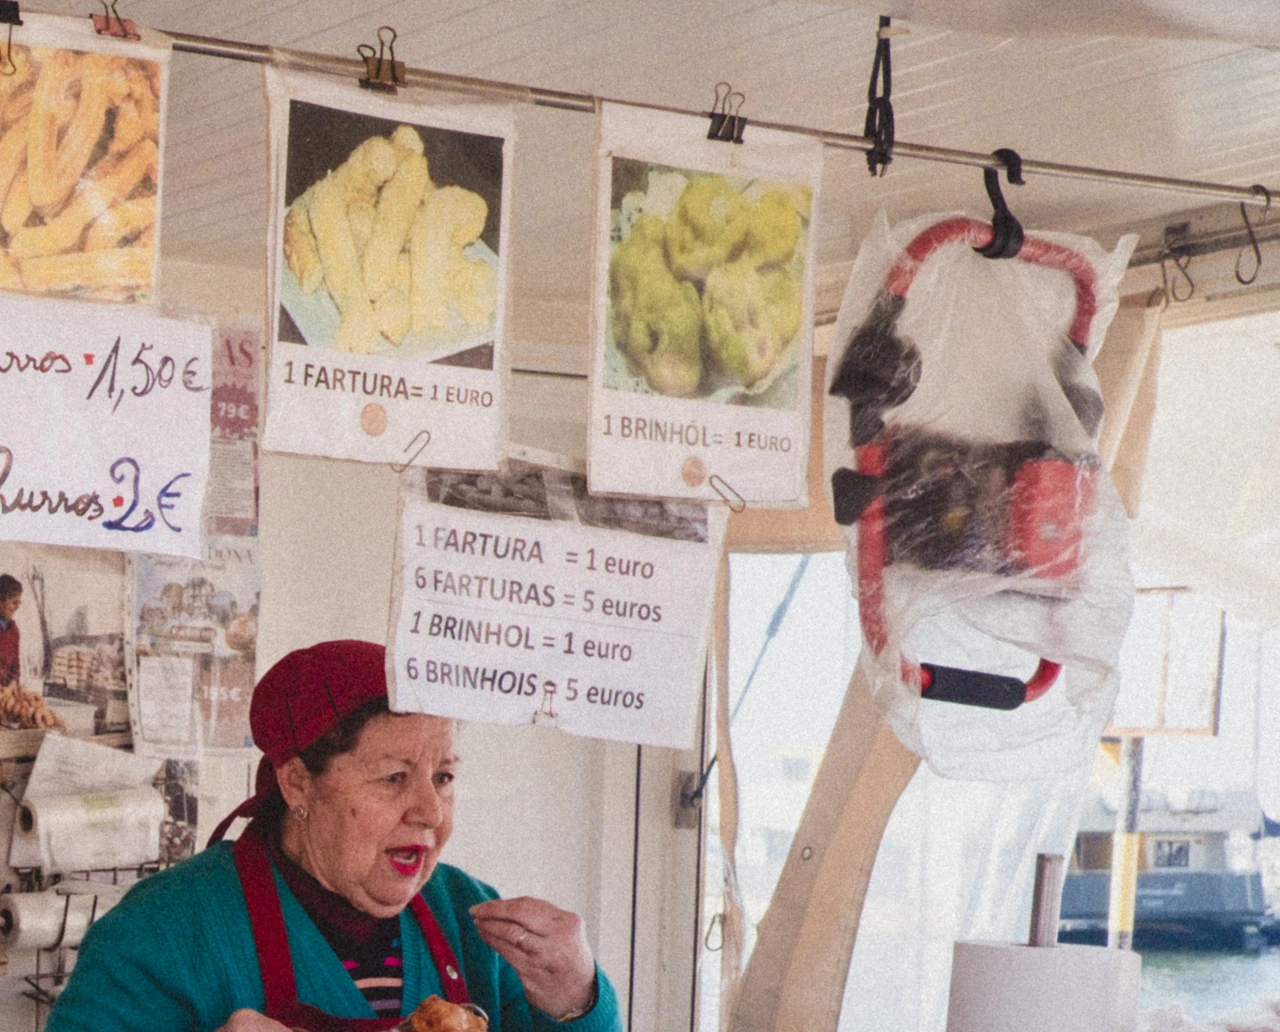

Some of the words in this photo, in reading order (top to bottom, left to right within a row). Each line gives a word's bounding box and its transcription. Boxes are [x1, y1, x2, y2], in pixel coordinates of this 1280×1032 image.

[283, 361, 295, 383] 1
[430, 384, 439, 400] 1
[446, 387, 494, 408] EURO
[603, 414, 612, 436] 1
[734, 431, 742, 447] 1
[748, 433, 792, 452] EURO
[416, 524, 426, 547] 1
[433, 526, 544, 564] FARTURA
[587, 548, 597, 571] 1
[604, 555, 654, 579] euro
[415, 567, 426, 589] 6
[433, 570, 555, 608] FARTURAS
[583, 590, 595, 612] 5
[602, 597, 662, 622] euros
[410, 611, 421, 634] 1
[429, 614, 534, 650] BRINHOL
[563, 632, 575, 655] 1
[583, 640, 632, 662] euro
[407, 658, 418, 680] 6
[426, 660, 537, 697] BRINHOIS
[565, 678, 578, 701] 5
[587, 685, 645, 711] euros
